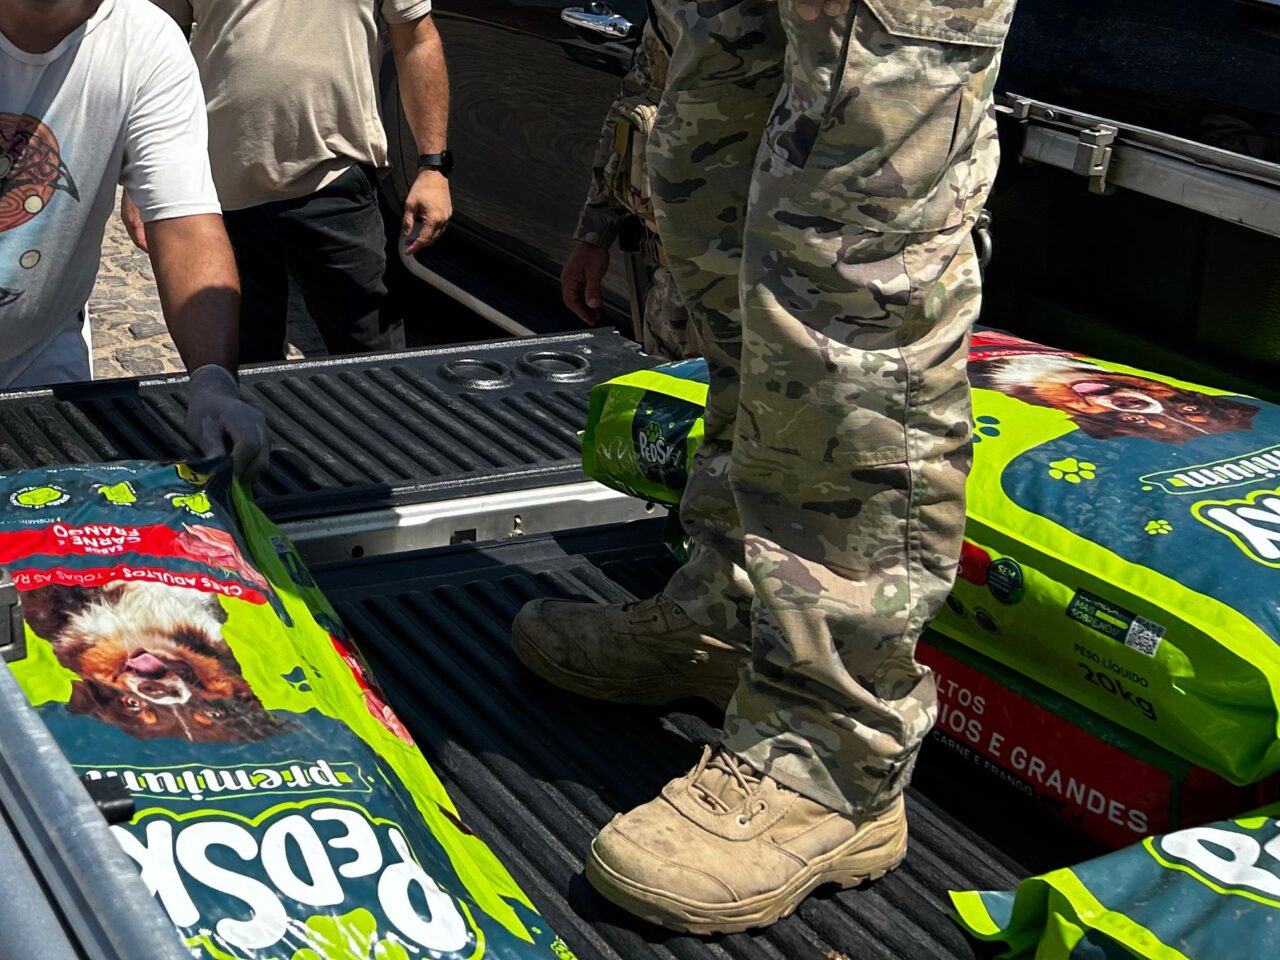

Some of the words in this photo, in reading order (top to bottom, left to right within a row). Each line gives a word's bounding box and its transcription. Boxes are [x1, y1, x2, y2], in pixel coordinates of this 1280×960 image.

[52, 525, 140, 539] FRANGO
[71, 534, 142, 548] CARNE
[84, 544, 124, 556] SABOR
[32, 573, 52, 585] AS
[55, 570, 103, 584] TODAS
[122, 567, 197, 589] ADULTOS
[997, 564, 1016, 579] SEM
[1073, 642, 1100, 663] PESO
[1102, 655, 1149, 688] LÍQUIDO
[933, 672, 986, 716] LTOS
[1077, 661, 1158, 721] 20kg
[932, 729, 972, 760] CARNE
[973, 752, 982, 767] E
[983, 757, 1034, 798] FRANGO
[937, 699, 983, 745] IOS
[987, 731, 1006, 758] E
[1010, 744, 1149, 835] GRANDES
